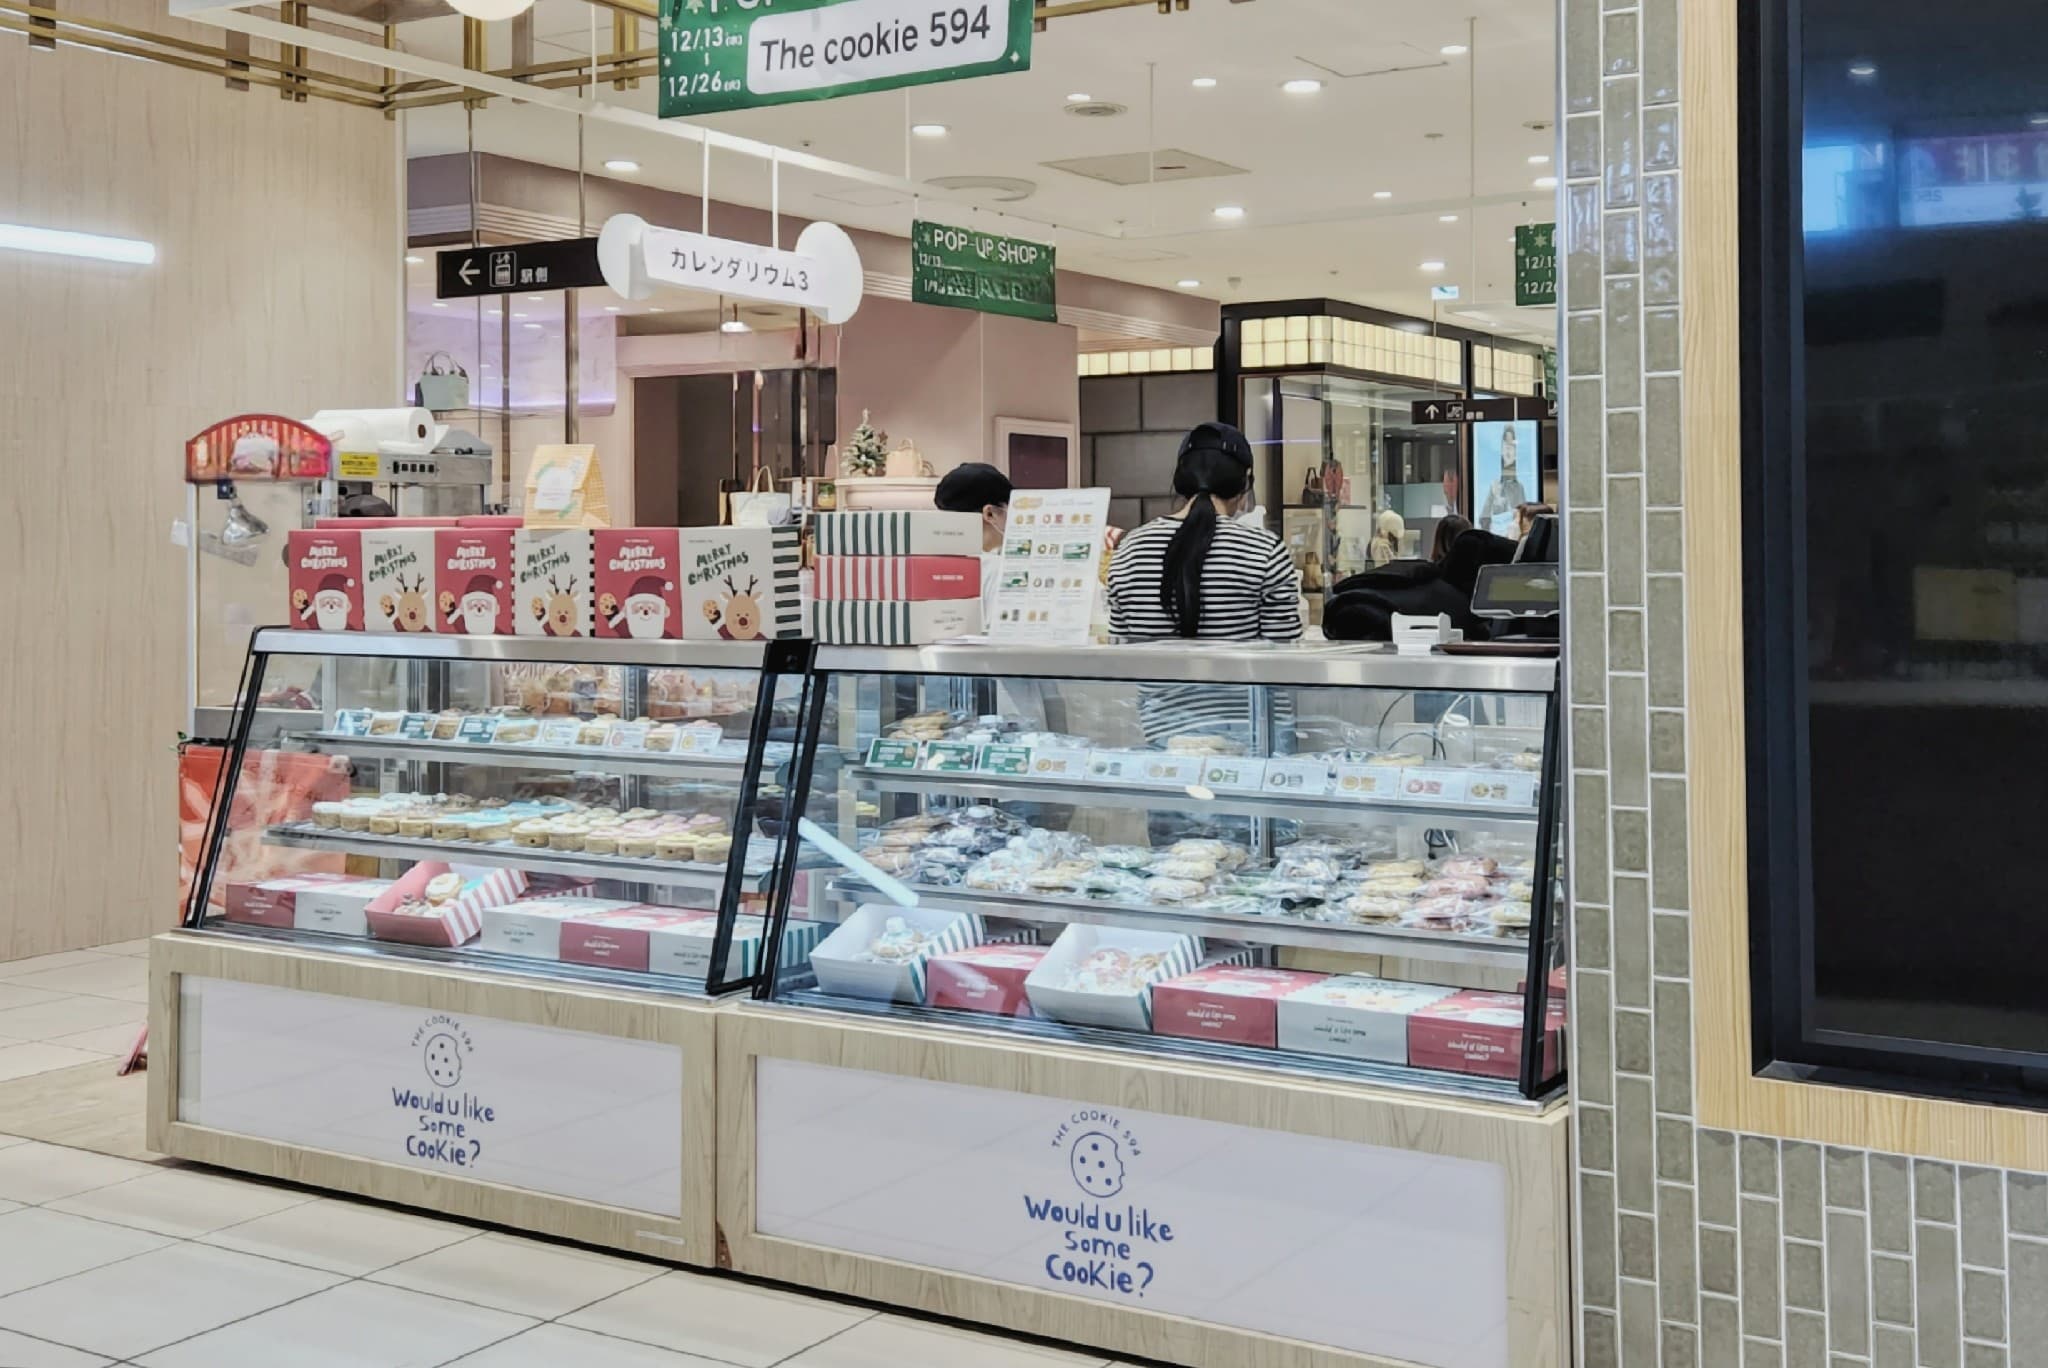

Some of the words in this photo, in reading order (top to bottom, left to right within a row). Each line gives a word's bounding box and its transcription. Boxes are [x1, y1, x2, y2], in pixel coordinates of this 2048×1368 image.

[760, 38, 814, 71] The
[824, 19, 919, 65] cookie
[929, 4, 990, 47] 594
[934, 229, 994, 259] POP-UP
[998, 241, 1038, 264] SHOP
[671, 248, 810, 291] カレンダリウム3
[392, 1086, 444, 1114] Would
[464, 1092, 495, 1123] like
[1052, 1123, 1069, 1148] THE
[1071, 1110, 1120, 1129] COOKIE
[1024, 1194, 1099, 1230] Would
[1129, 1205, 1174, 1243] like
